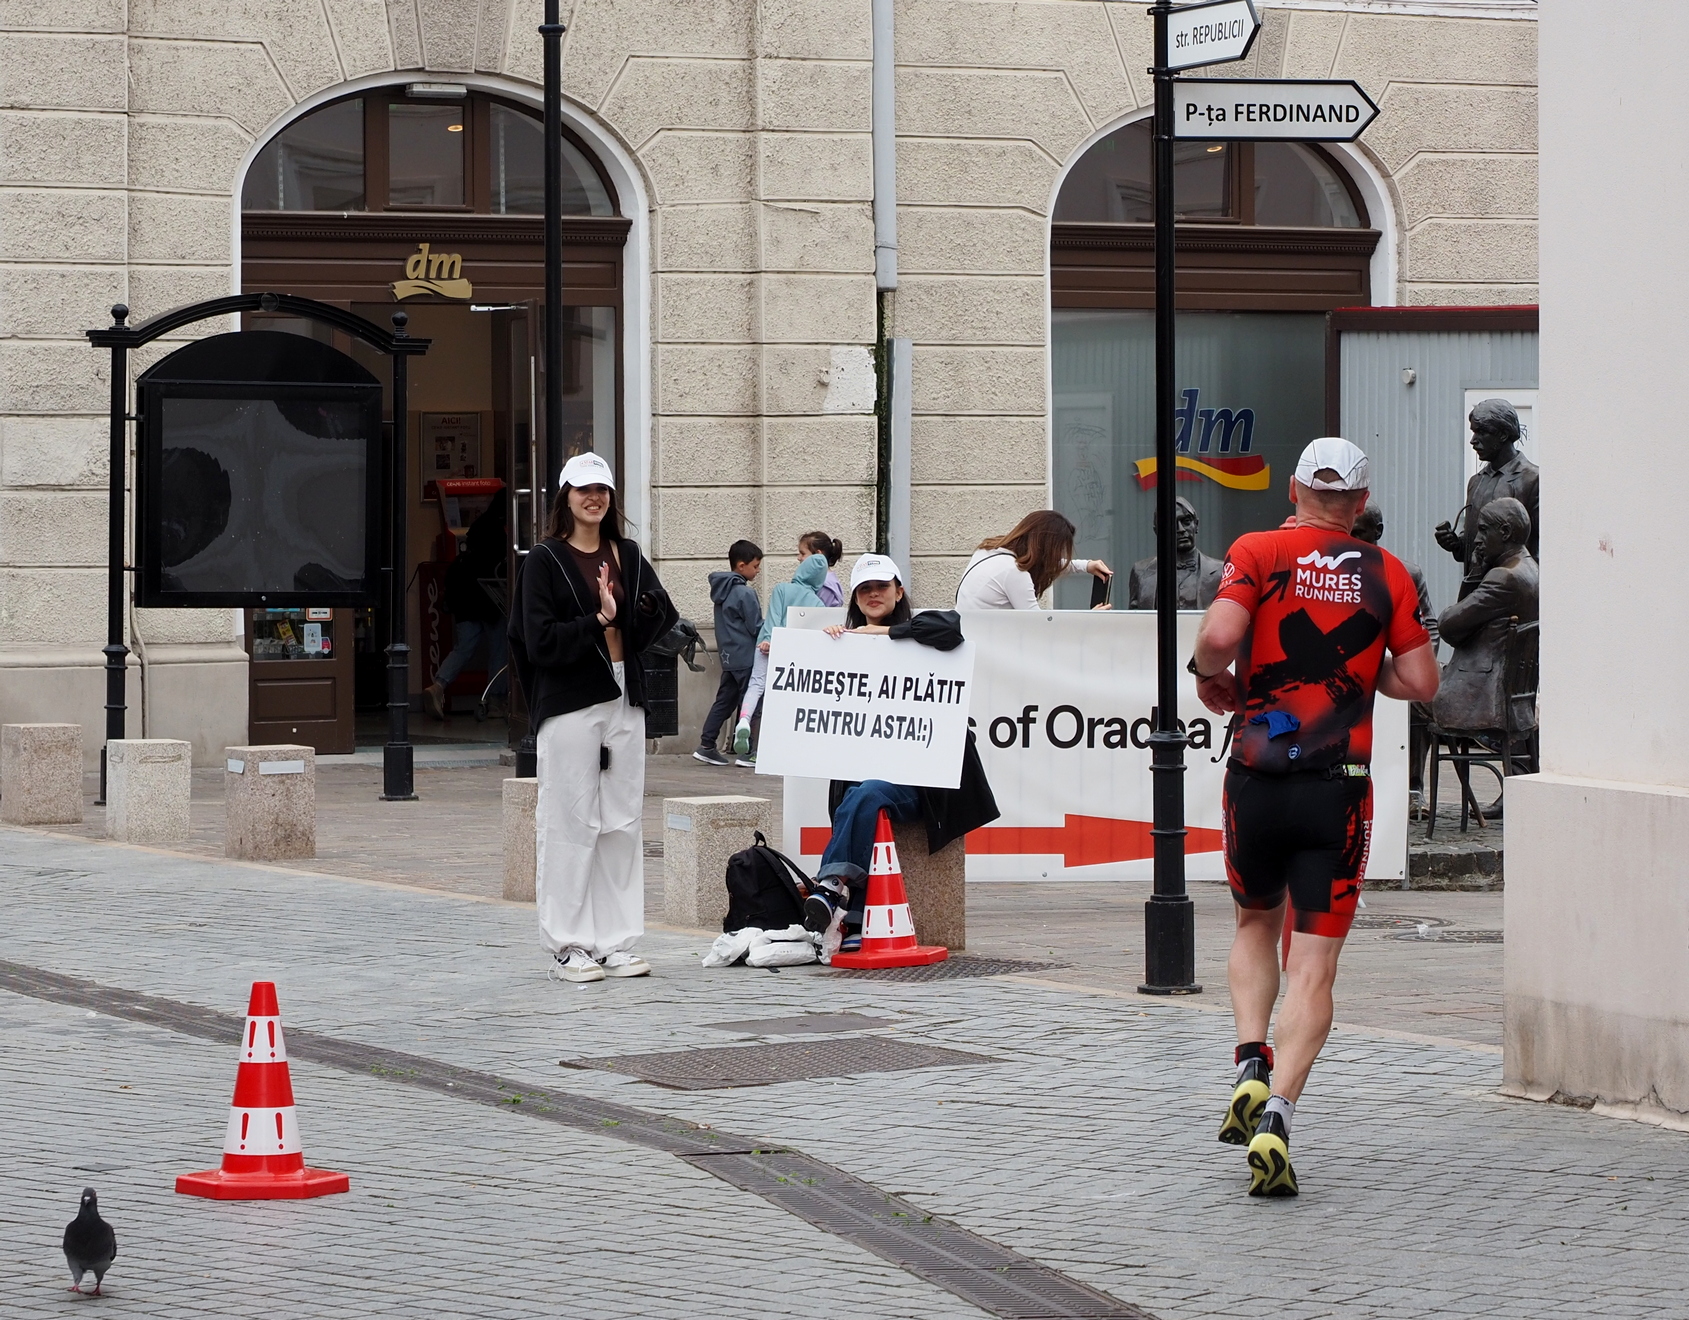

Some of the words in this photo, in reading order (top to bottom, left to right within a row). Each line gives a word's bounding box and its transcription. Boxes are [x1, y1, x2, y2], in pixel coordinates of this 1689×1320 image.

[1176, 30, 1190, 48] str.
[1192, 18, 1245, 45] REPUBLICII
[1185, 103, 1226, 126] P-ța
[1234, 103, 1360, 123] FERDINAND
[406, 243, 462, 279] dm
[441, 417, 461, 425] AICI!
[1175, 387, 1256, 454] dm
[1295, 584, 1361, 604] RUNNERS
[877, 675, 898, 700] AI
[902, 672, 966, 705] PLĂTIT
[793, 707, 867, 737] PENTRU
[870, 714, 934, 749] ASTA!:)
[988, 704, 1039, 749] of
[1045, 704, 1212, 750] Orada
[1356, 819, 1370, 889] RUNNERS
